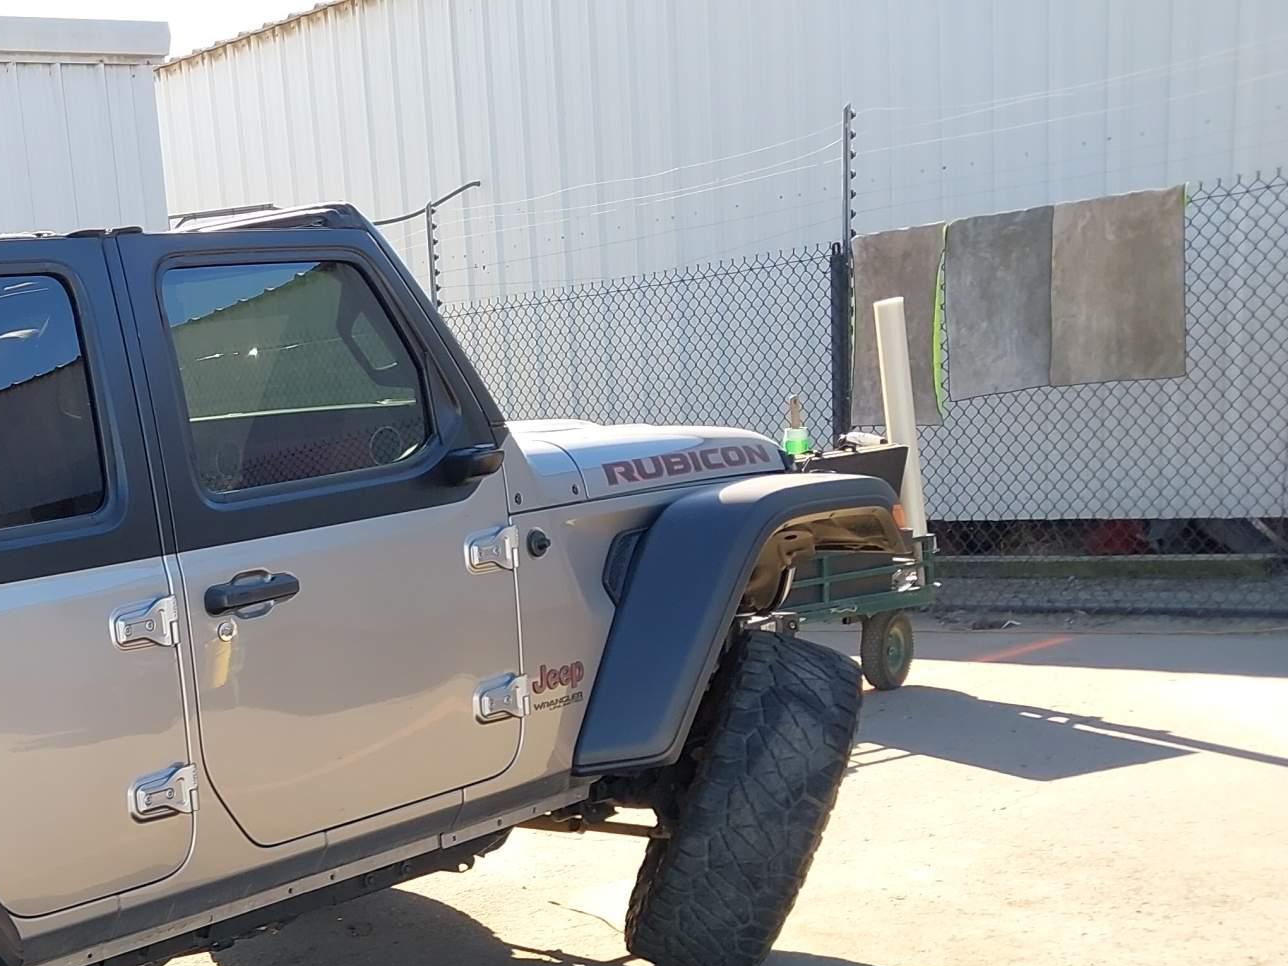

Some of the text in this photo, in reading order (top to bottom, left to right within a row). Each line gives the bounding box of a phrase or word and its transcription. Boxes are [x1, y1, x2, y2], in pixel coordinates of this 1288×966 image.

[601, 444, 771, 486] RUBICON
[532, 660, 584, 695] Jeep
[533, 691, 584, 711] WRANGLER
